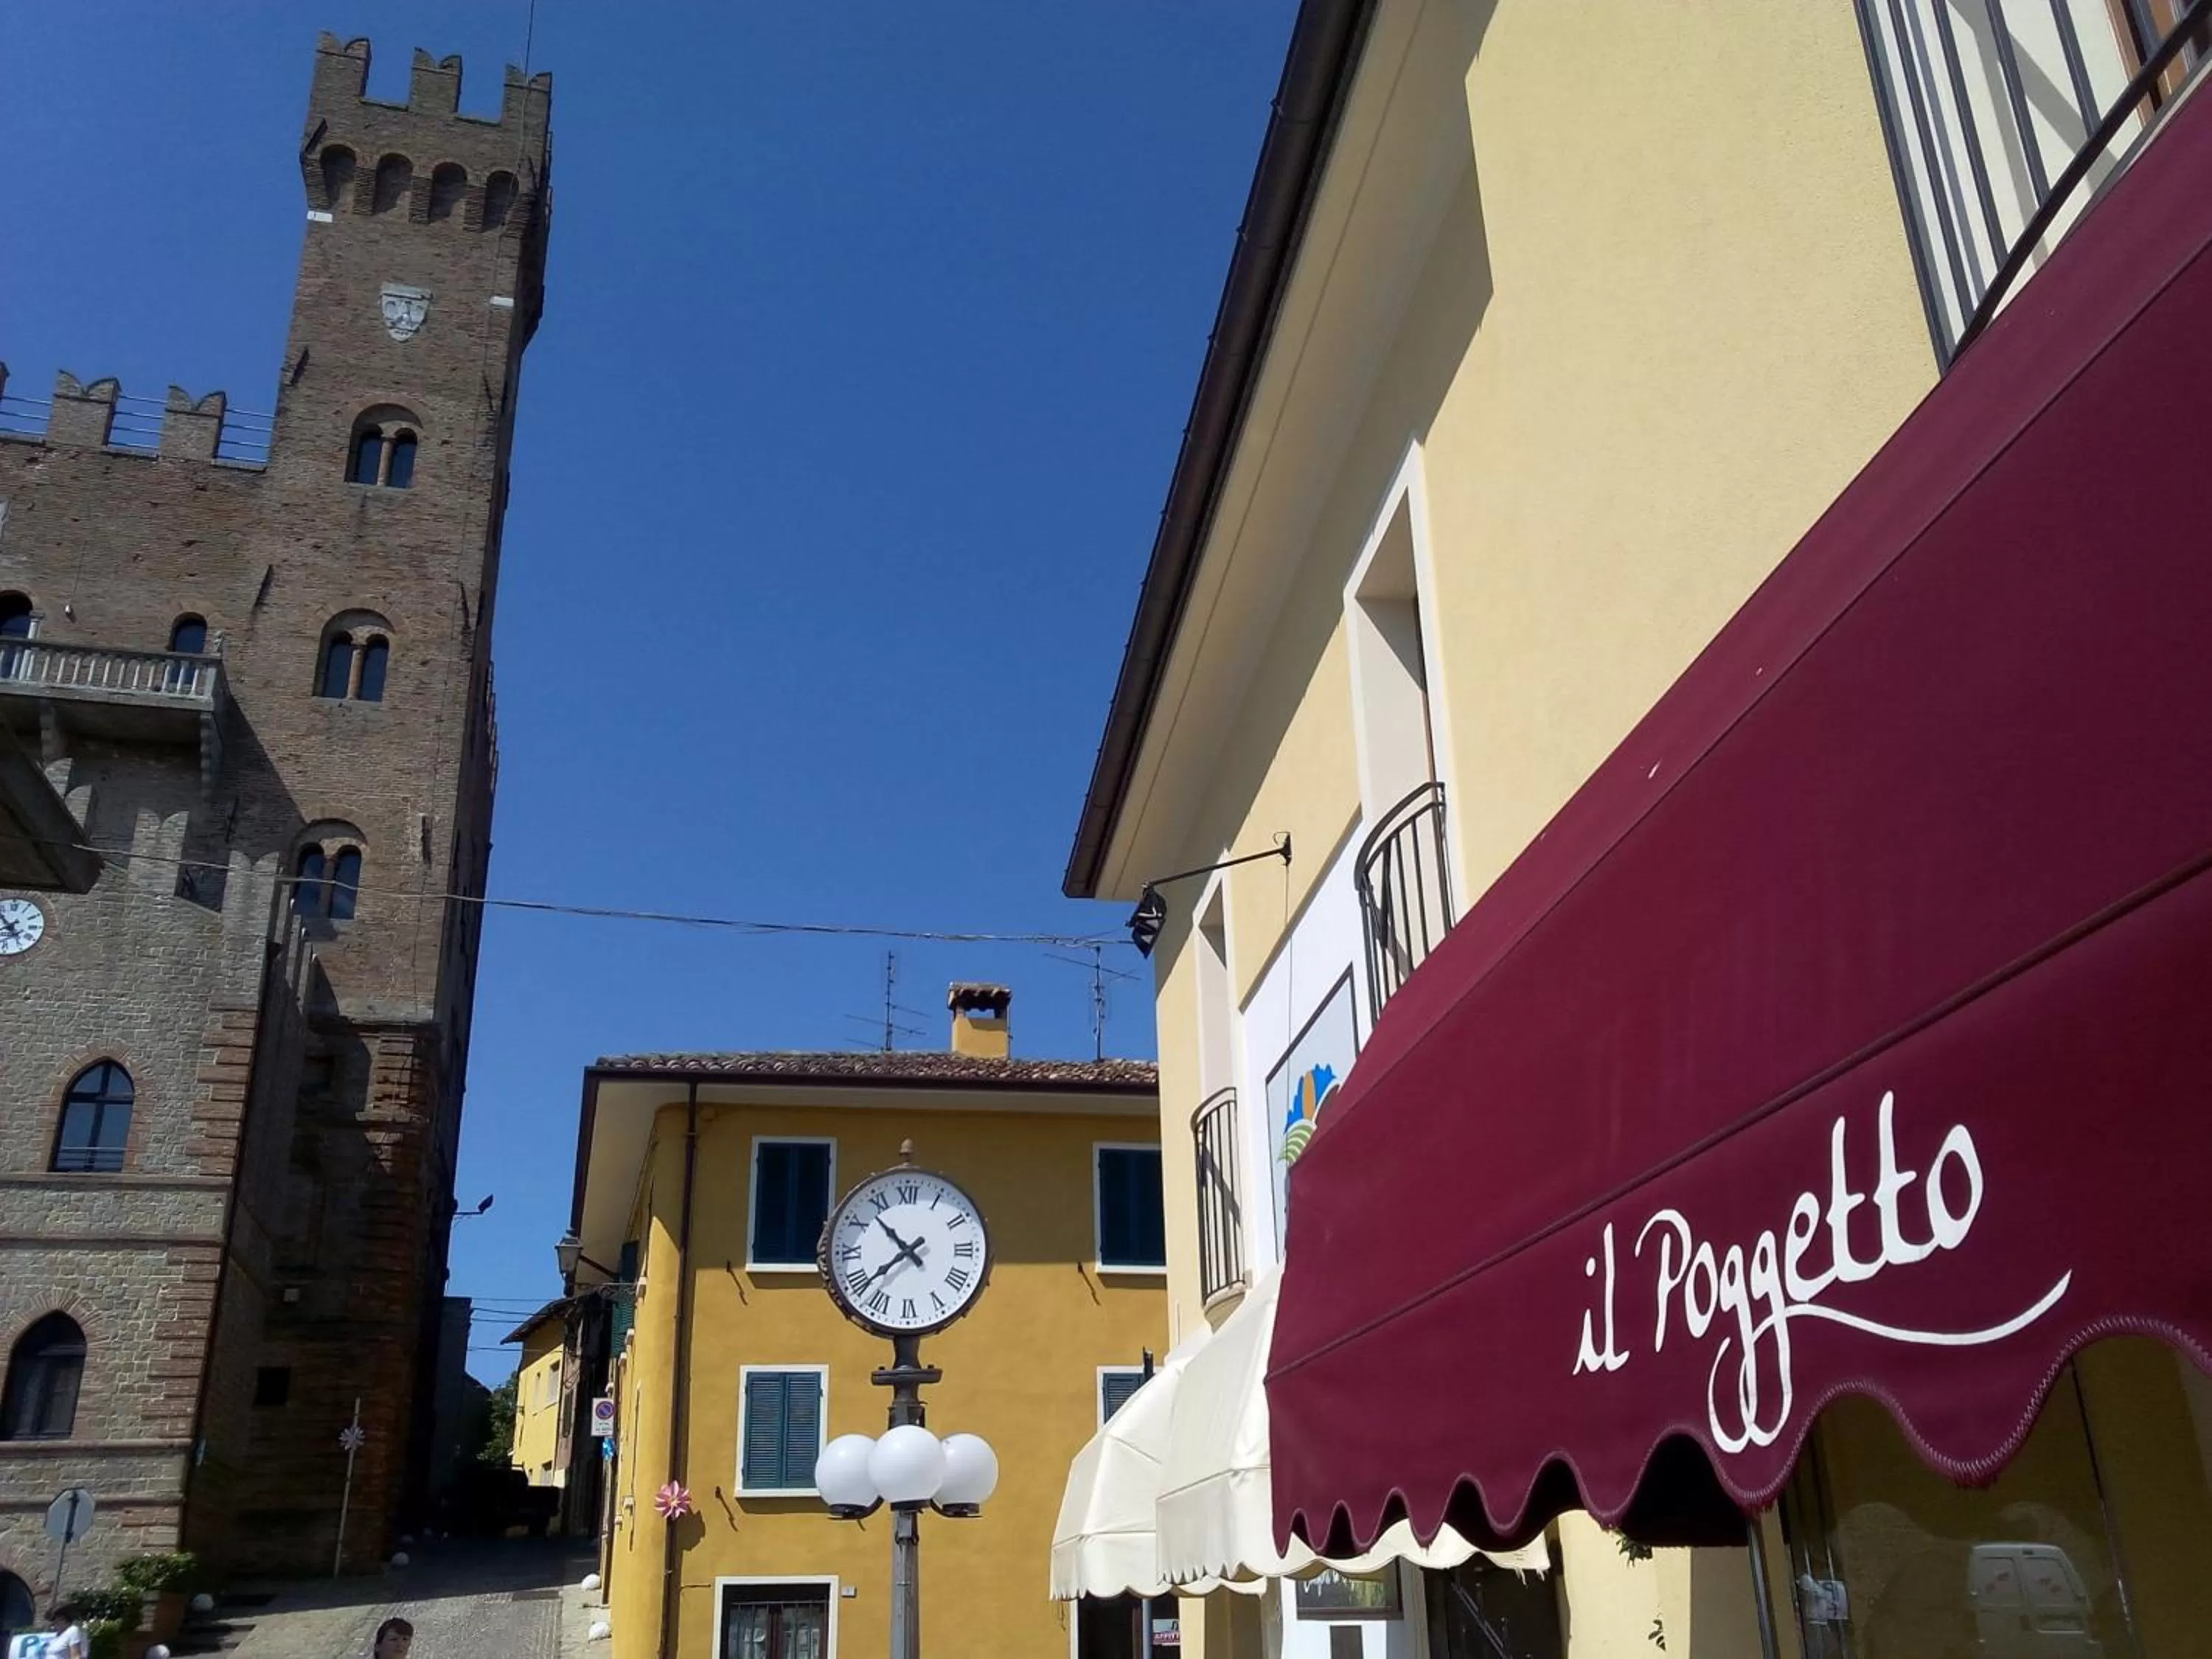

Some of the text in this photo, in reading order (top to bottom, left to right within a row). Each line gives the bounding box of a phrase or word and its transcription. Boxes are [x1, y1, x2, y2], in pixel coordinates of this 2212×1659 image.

[868, 1191, 891, 1213] XI
[897, 1186, 920, 1205] XII
[929, 1193, 942, 1211] I
[849, 1214, 869, 1233] X
[946, 1212, 965, 1232] II
[842, 1243, 861, 1262] IX
[954, 1240, 973, 1260] III
[945, 1267, 969, 1293] IIII
[1572, 1091, 2073, 1453] il Poggetto
[868, 1289, 891, 1315] VII
[900, 1298, 918, 1319] VI
[929, 1291, 945, 1311] V
